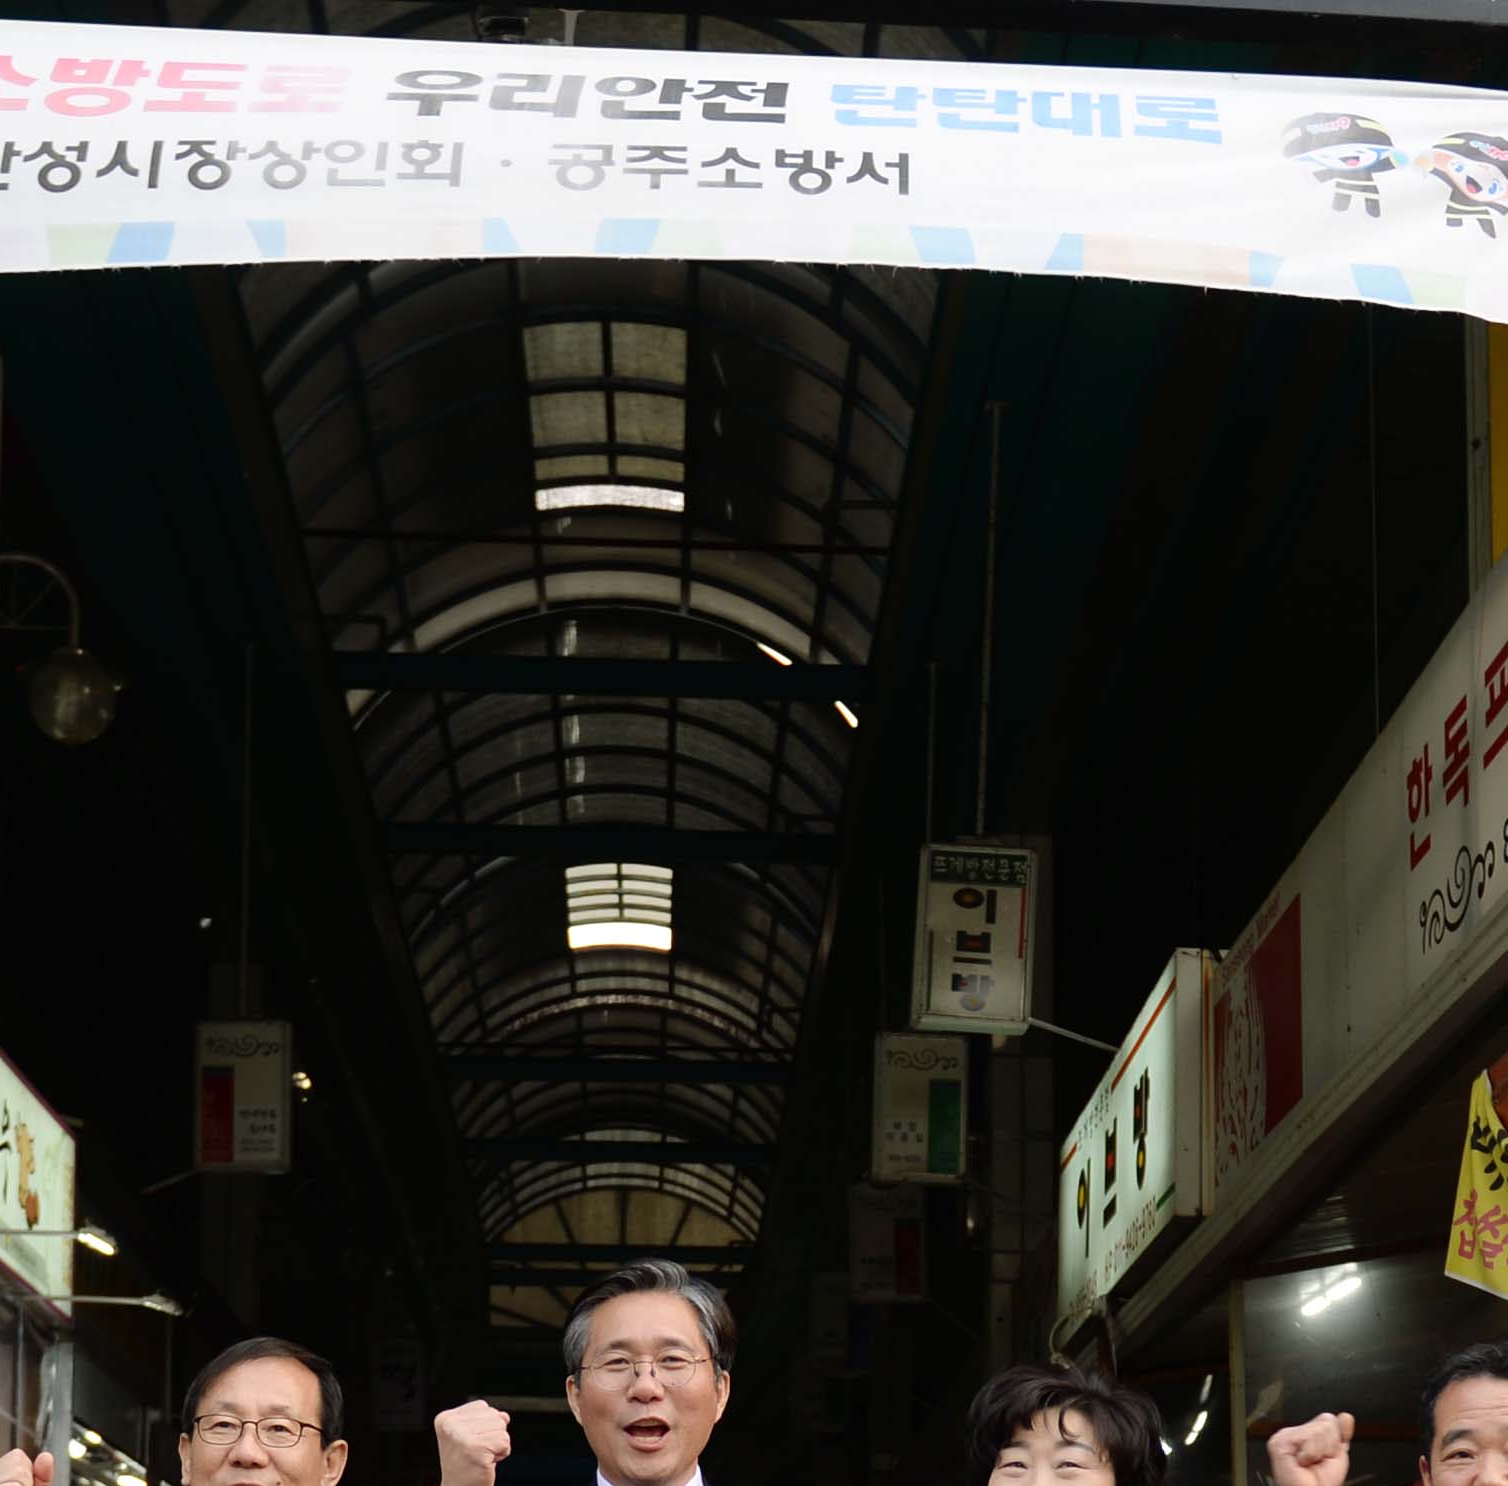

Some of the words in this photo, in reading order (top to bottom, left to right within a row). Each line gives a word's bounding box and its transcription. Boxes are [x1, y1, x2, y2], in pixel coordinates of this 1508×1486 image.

[385, 66, 791, 123] 우리안전
[828, 82, 1225, 145] 탄탄대로
[546, 143, 914, 198] 공주소방서
[952, 887, 998, 1012] 이브방
[1076, 1066, 1152, 1259] 이브방
